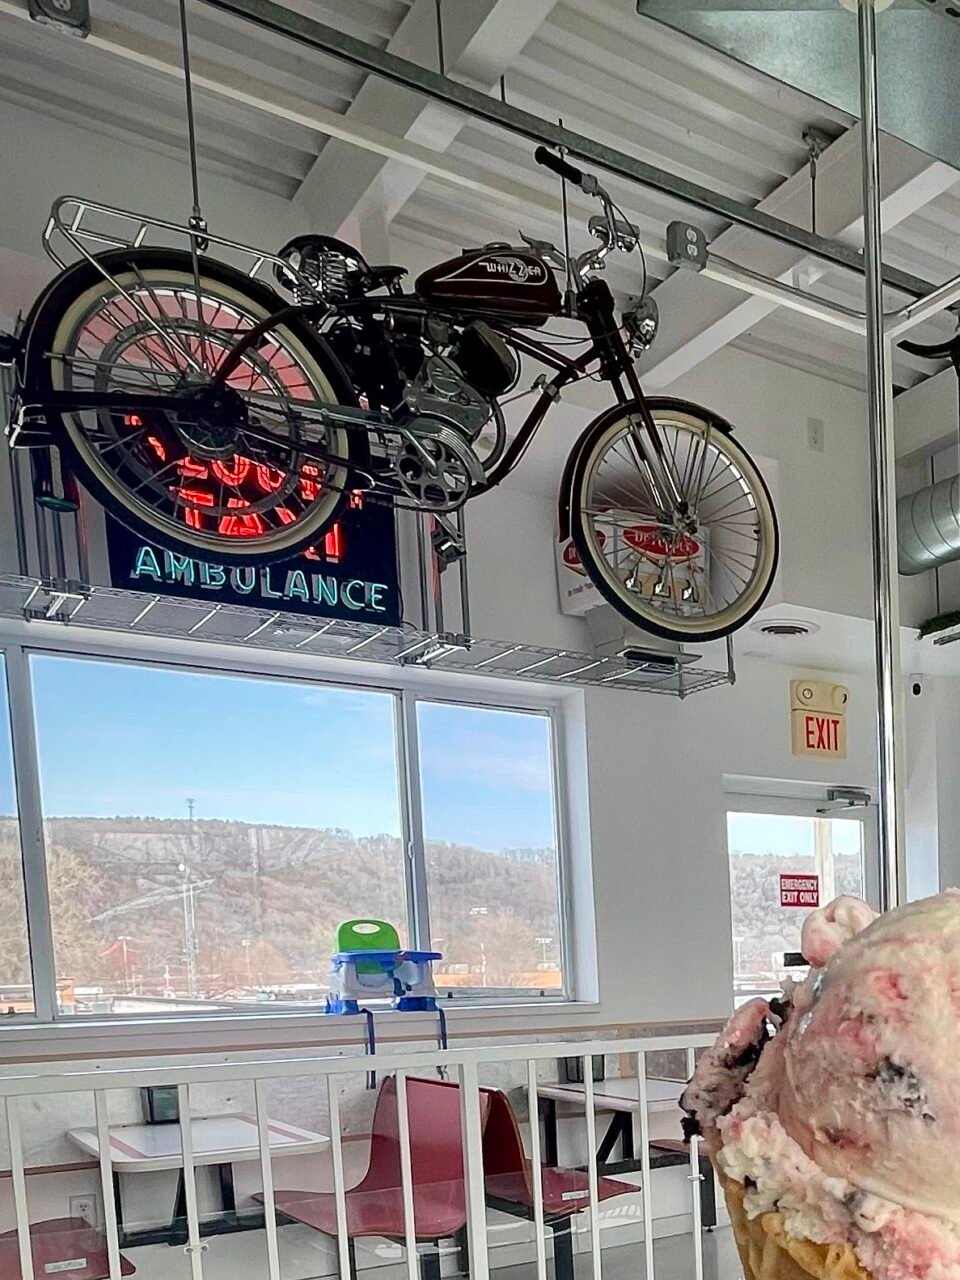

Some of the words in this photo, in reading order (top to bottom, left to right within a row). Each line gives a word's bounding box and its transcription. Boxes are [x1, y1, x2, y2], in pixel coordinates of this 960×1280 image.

[130, 546, 389, 612] AMBULANCE
[804, 715, 840, 751] EXIT
[781, 891, 798, 903] EXIT
[799, 891, 818, 904] ONLY
